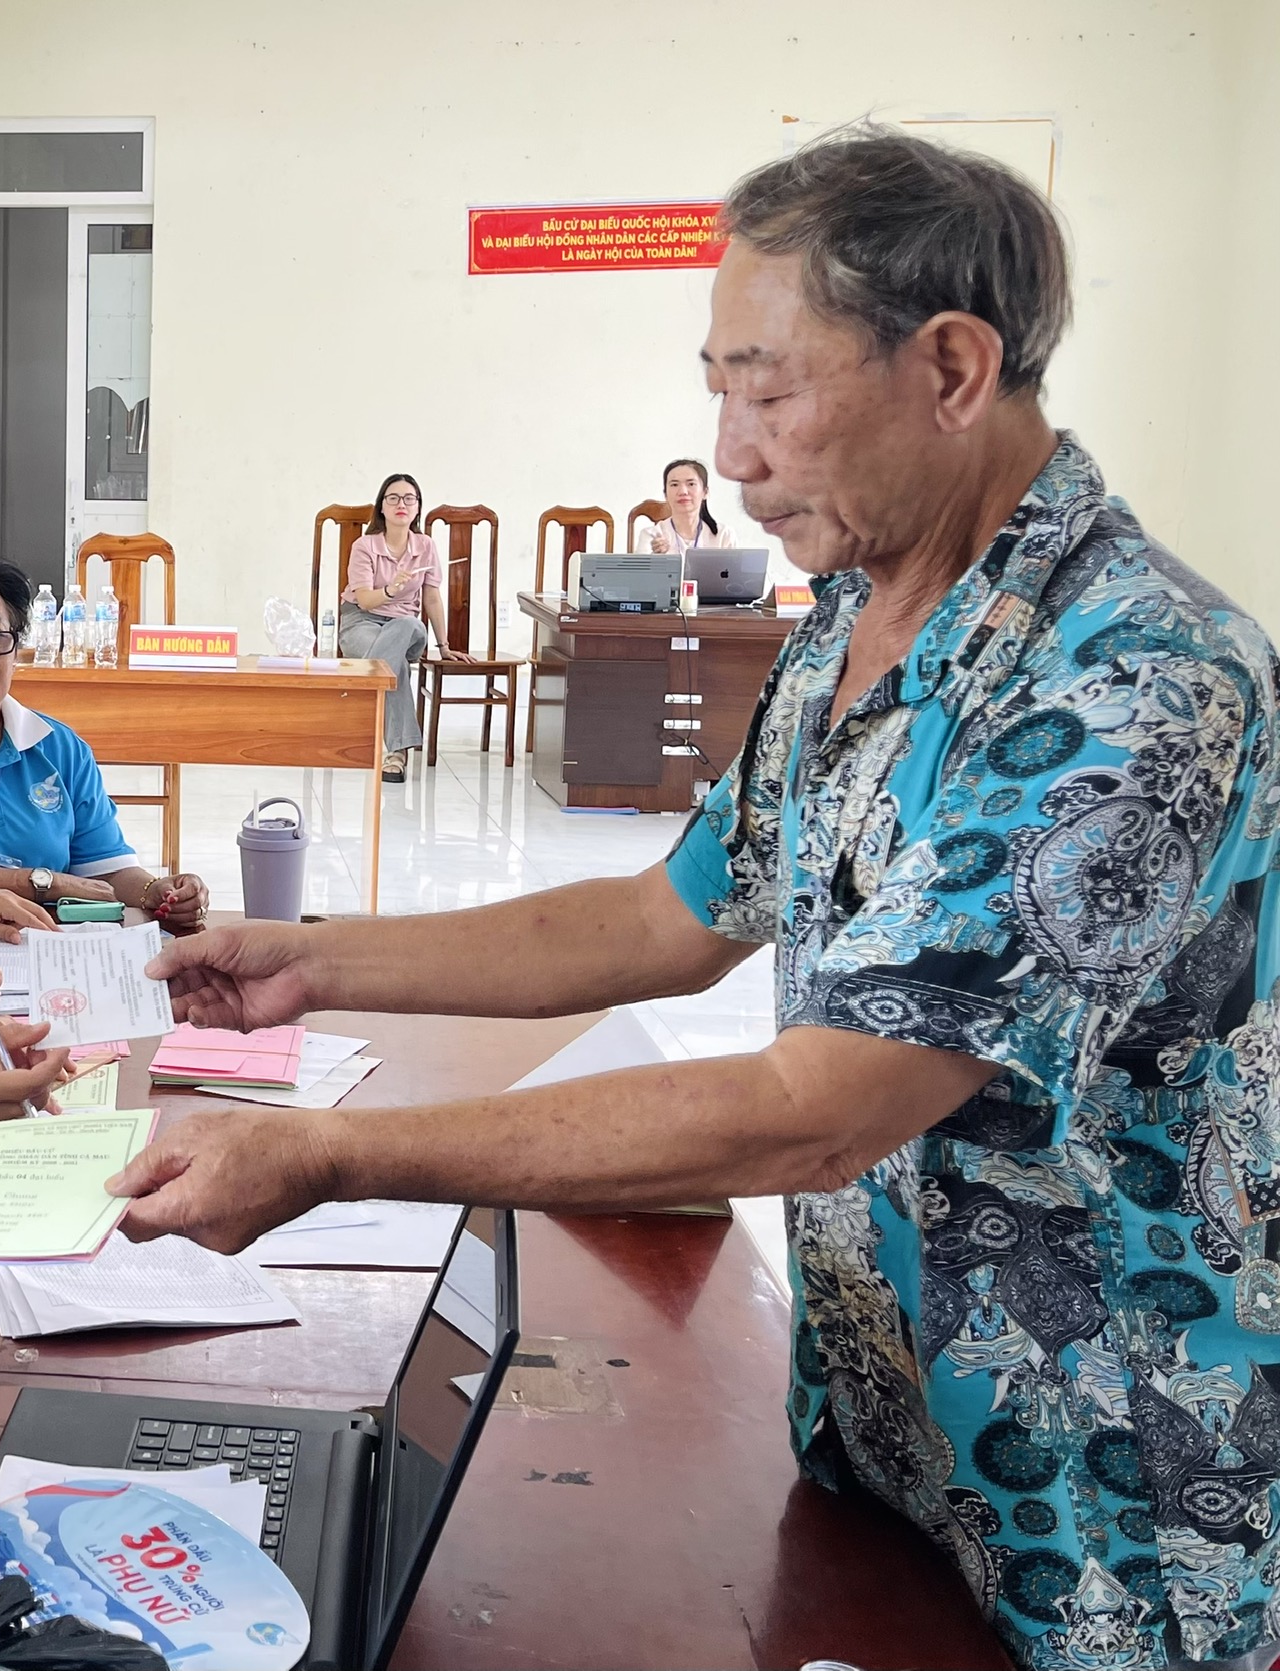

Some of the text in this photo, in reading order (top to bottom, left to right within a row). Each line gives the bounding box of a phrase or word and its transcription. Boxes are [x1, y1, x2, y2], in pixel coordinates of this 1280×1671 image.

[622, 215, 650, 230] QUỐC
[653, 214, 670, 231] HỘI
[672, 214, 699, 228] KHÓA
[482, 235, 494, 248] VÀ
[537, 234, 554, 250] HỘI
[586, 232, 613, 245] NHÂN
[616, 231, 635, 244] DÂN
[637, 230, 658, 243] CÁC
[660, 230, 679, 243] CẤP
[681, 229, 711, 245] NHIỆM
[562, 244, 697, 262] LÀ NGÀY HỘI CỦA TOÀN DÂN!
[163, 636, 203, 653] HƯỚNG
[163, 1521, 212, 1563] PHẤN ĐẤU
[85, 1544, 107, 1558] LÀ
[97, 1554, 154, 1593] PHỤ
[138, 1595, 192, 1625] NỮ
[159, 1574, 209, 1616] TRÚNG CỬ
[189, 1582, 225, 1612] NGƯỜI
